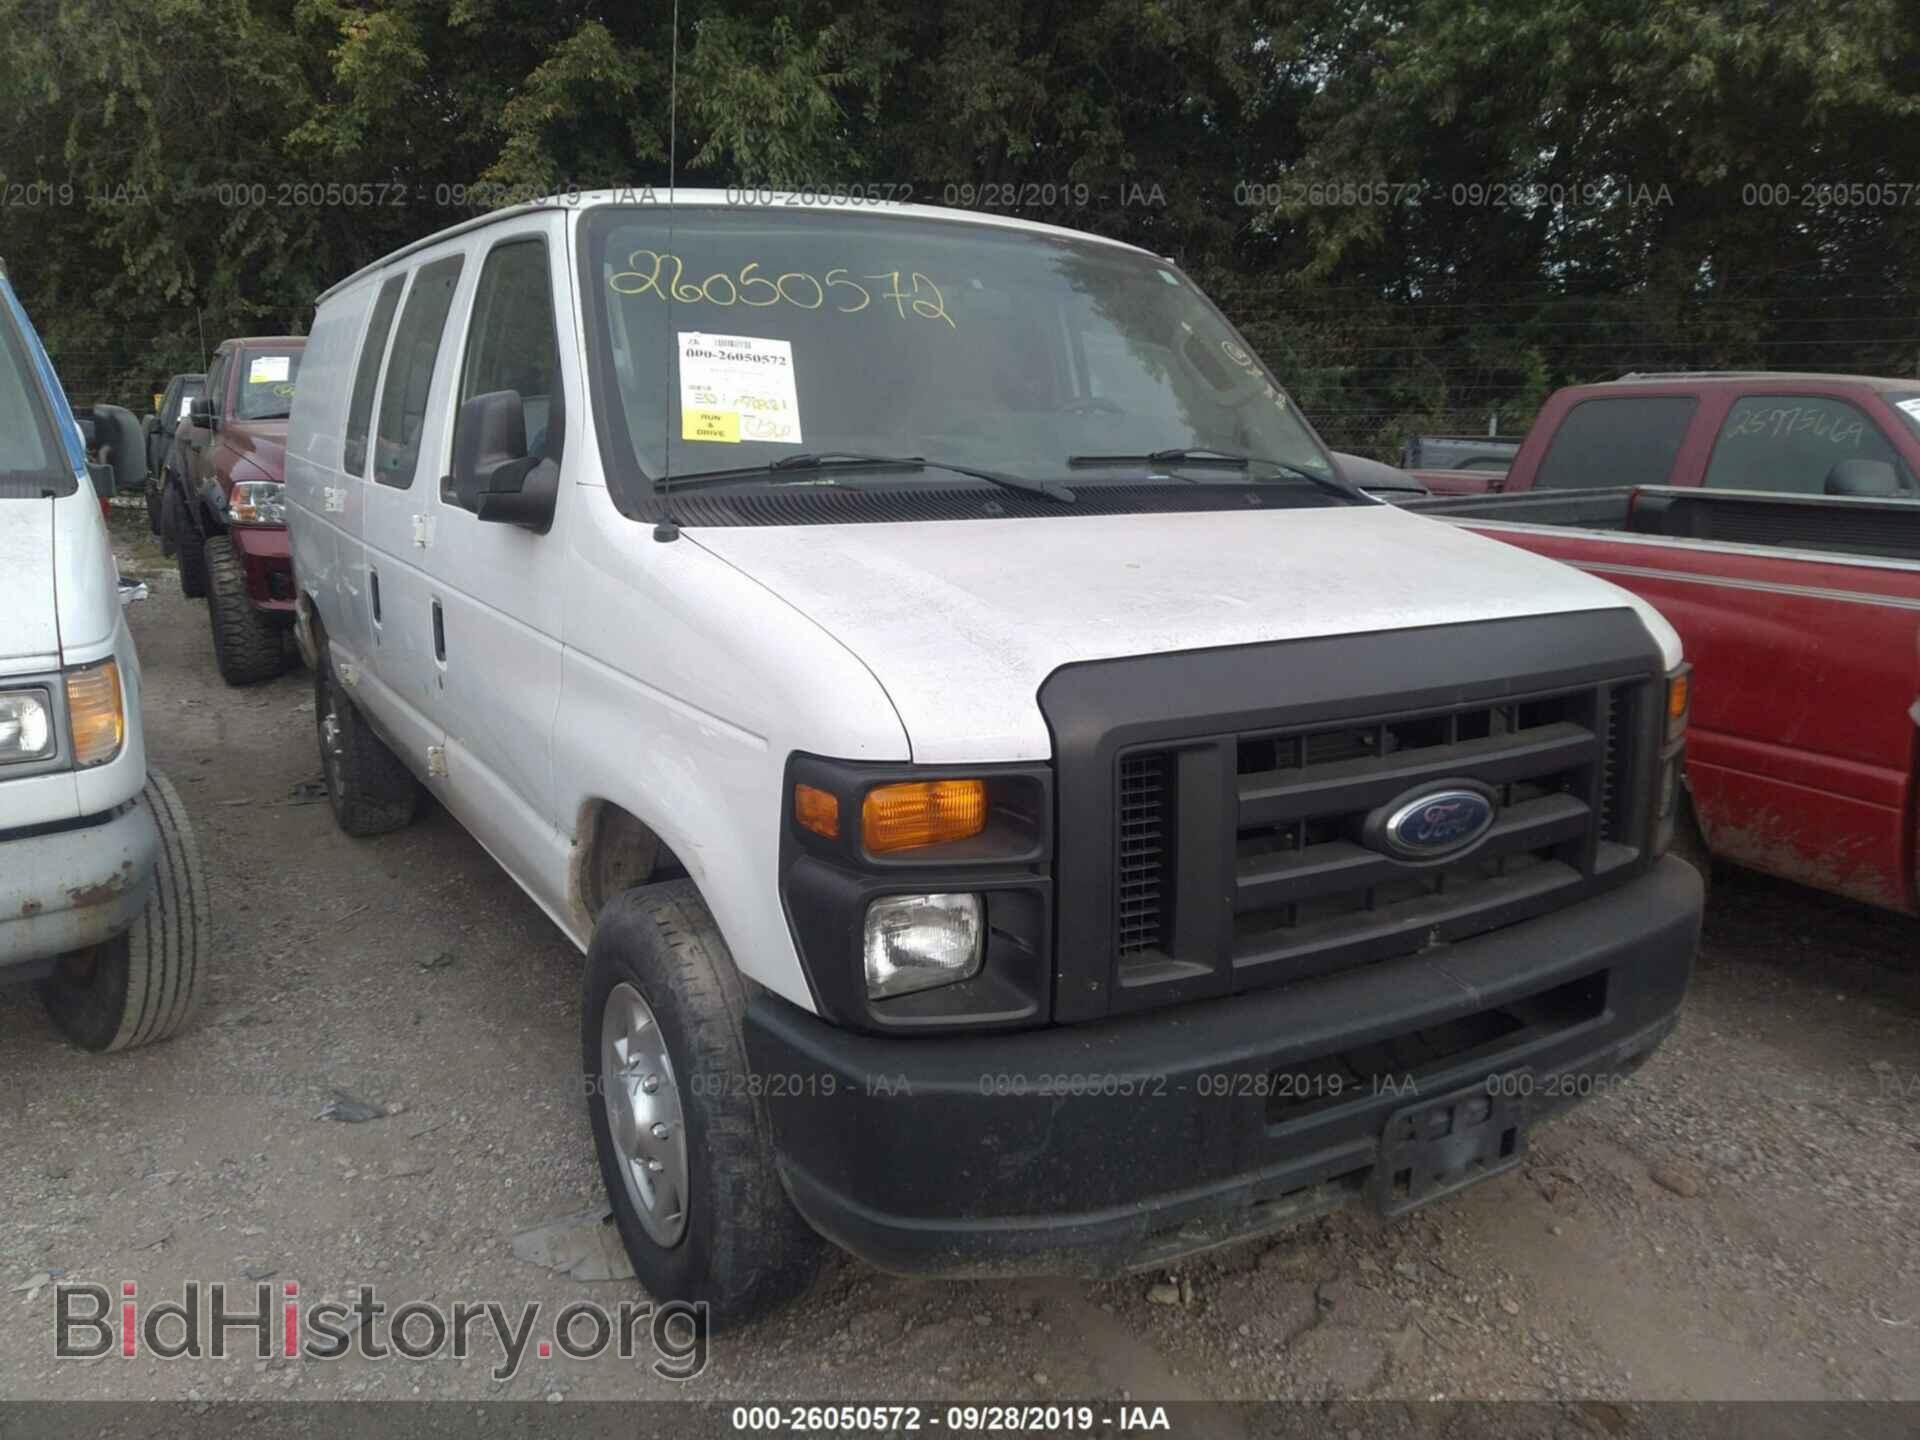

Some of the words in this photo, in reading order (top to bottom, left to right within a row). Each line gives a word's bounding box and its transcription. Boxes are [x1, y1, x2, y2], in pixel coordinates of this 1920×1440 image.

[609, 250, 956, 328] 26050572
[686, 348, 787, 366] 000-26050572
[696, 429, 726, 437] DRIVE
